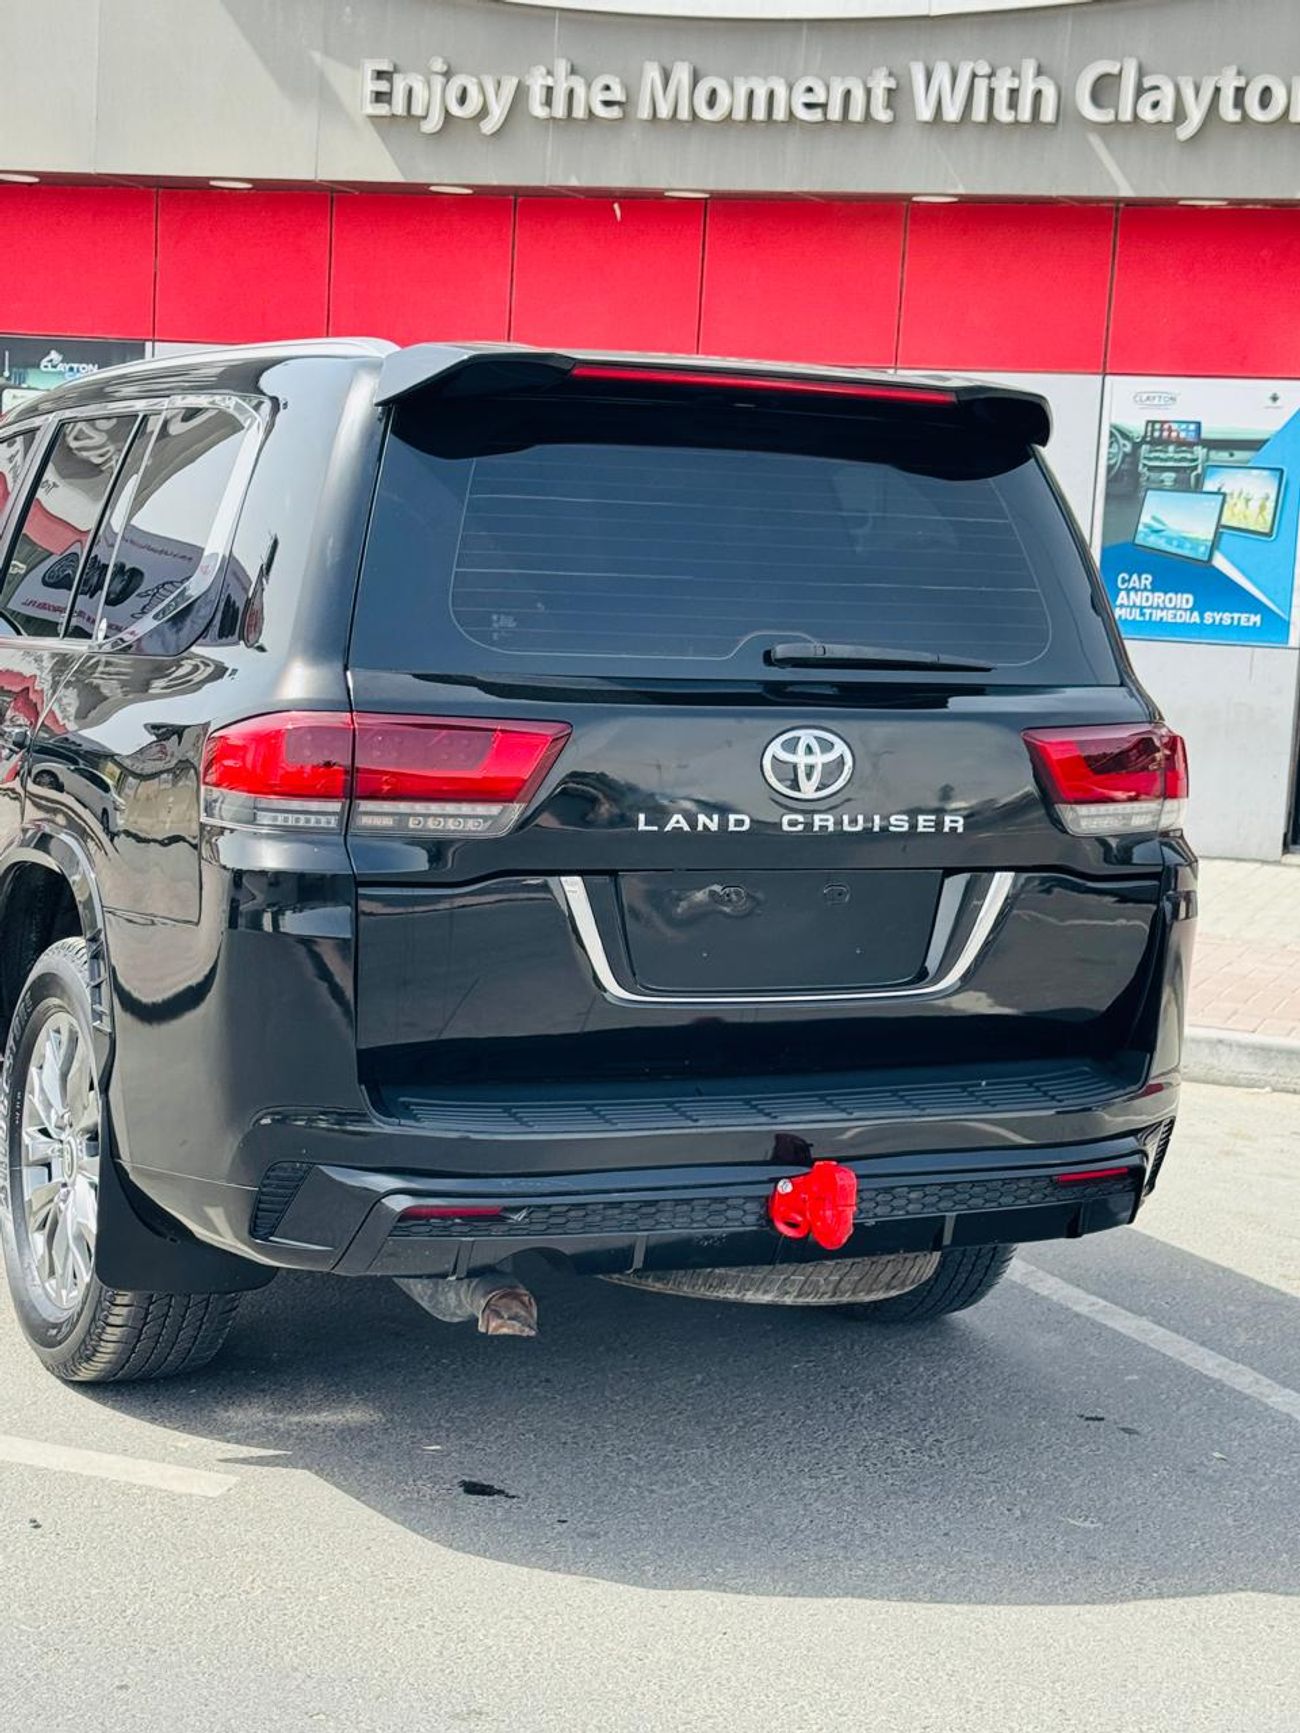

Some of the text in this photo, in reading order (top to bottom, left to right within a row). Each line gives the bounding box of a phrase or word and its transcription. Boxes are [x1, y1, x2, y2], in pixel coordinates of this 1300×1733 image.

[361, 56, 519, 136] Enjoy
[525, 57, 627, 120] the
[637, 60, 897, 123] Moment
[909, 57, 1060, 124] With
[1117, 573, 1153, 590] CAR
[1115, 590, 1194, 609] ANDROID
[1114, 607, 1262, 627] MULTIMEDIA SYSTEM
[637, 813, 966, 834] LAND CRUISER
